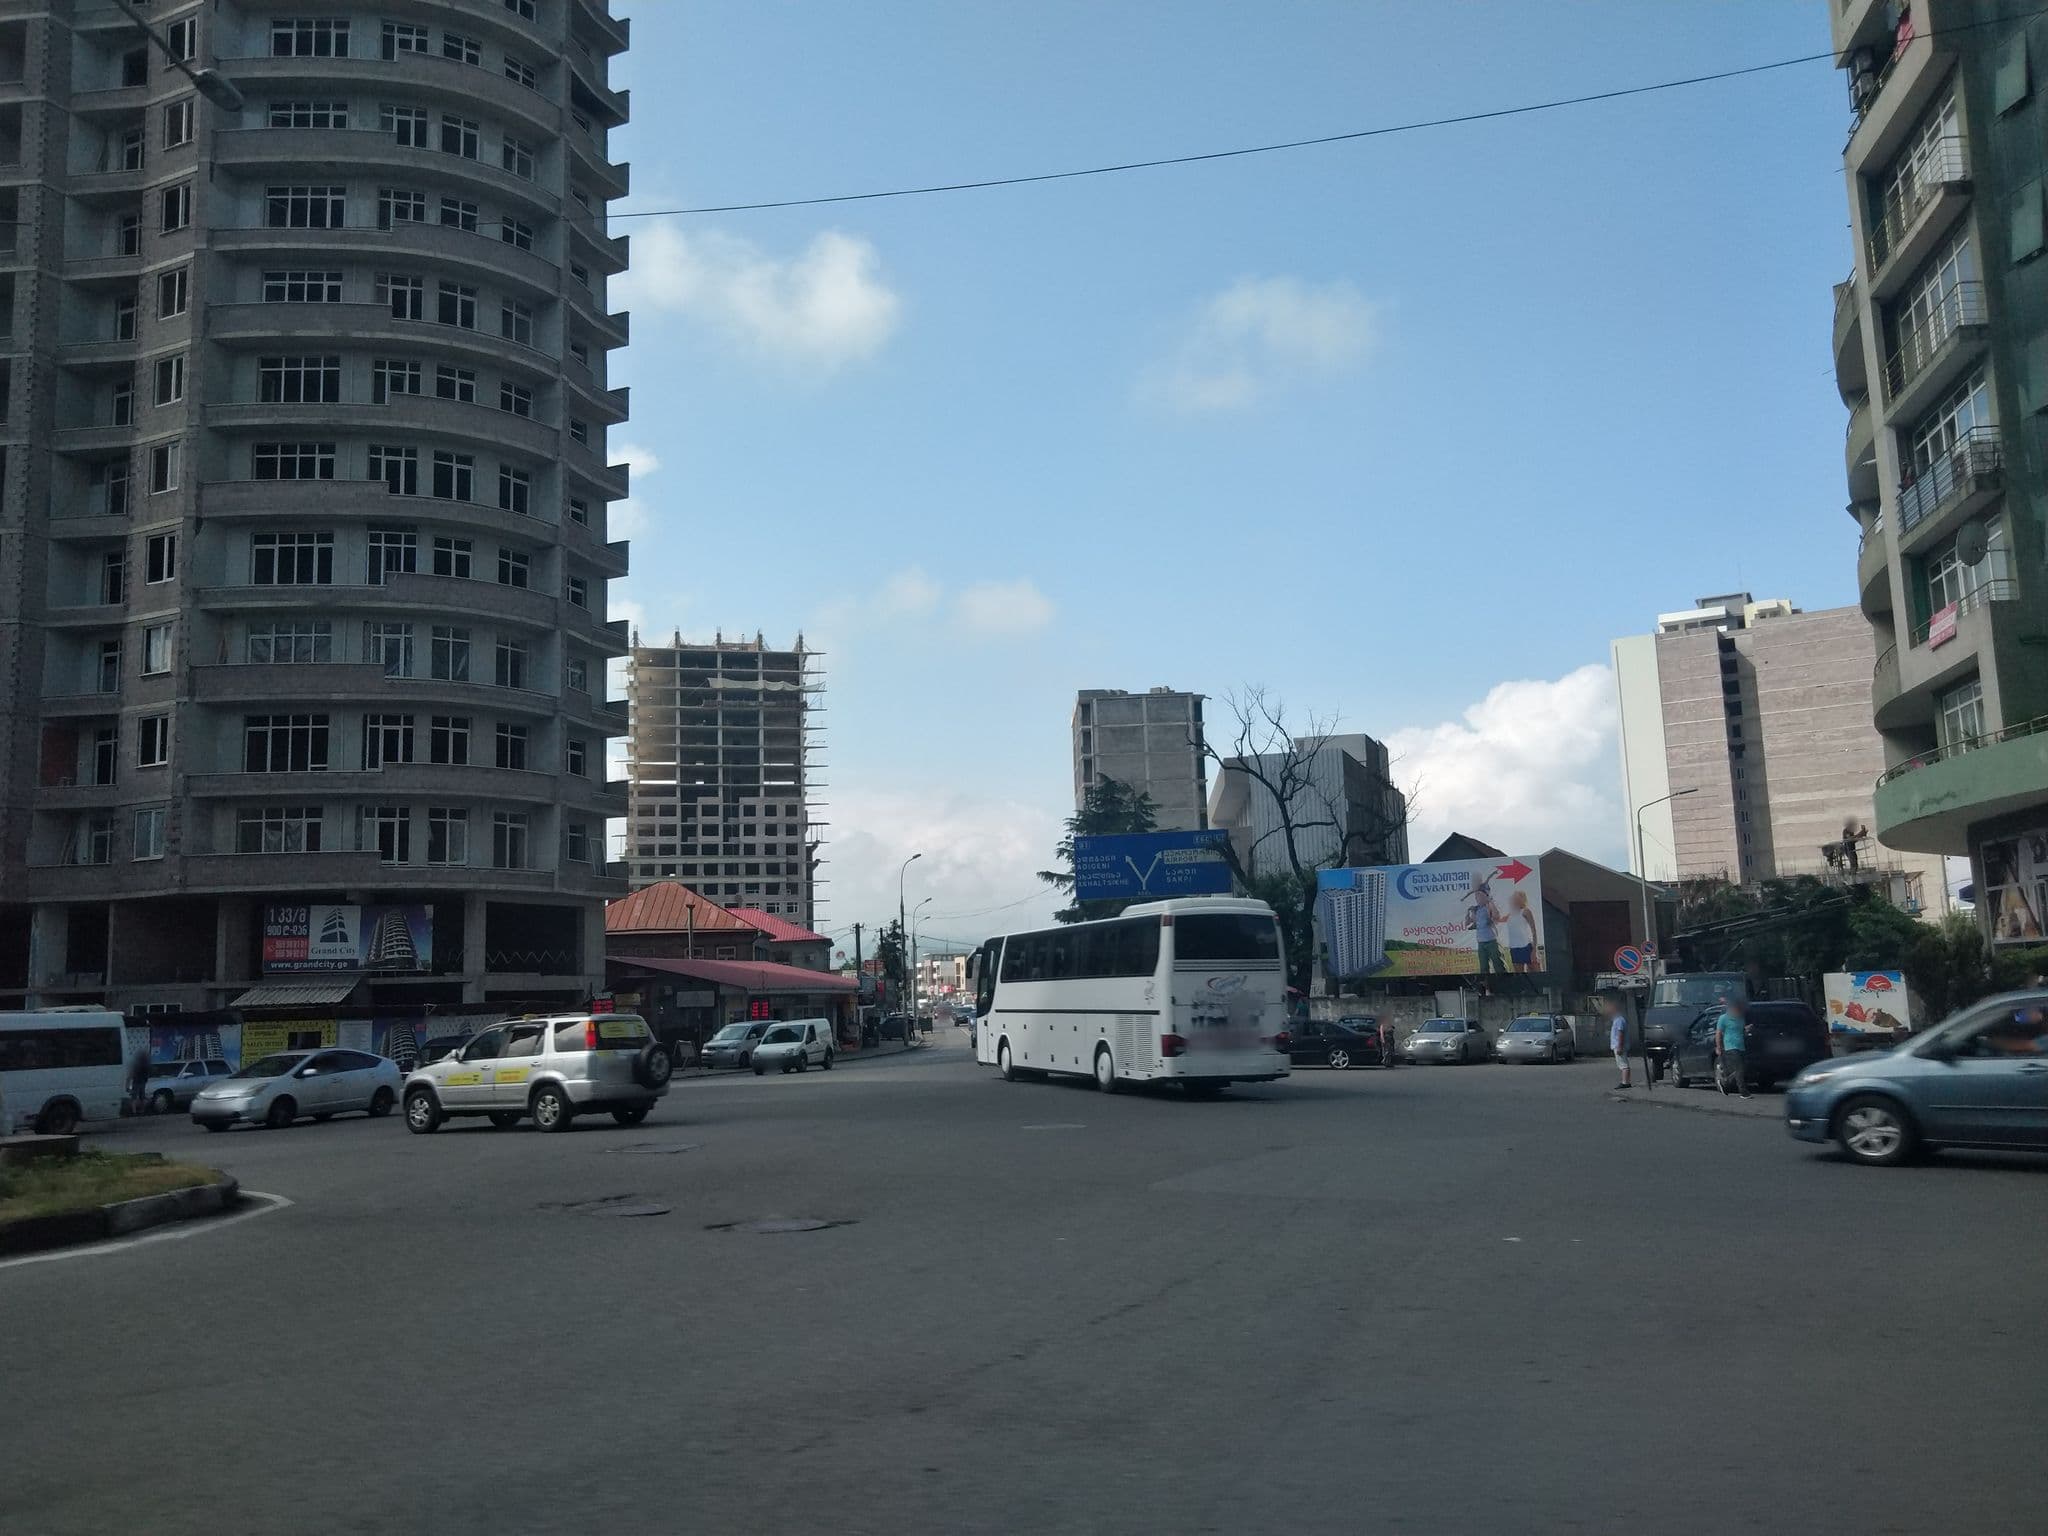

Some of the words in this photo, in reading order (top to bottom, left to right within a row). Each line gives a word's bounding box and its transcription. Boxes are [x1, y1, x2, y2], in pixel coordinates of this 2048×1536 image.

[311, 945, 337, 955] Grand
[340, 945, 356, 955] City
[270, 960, 348, 969] www.grandcity.ge
